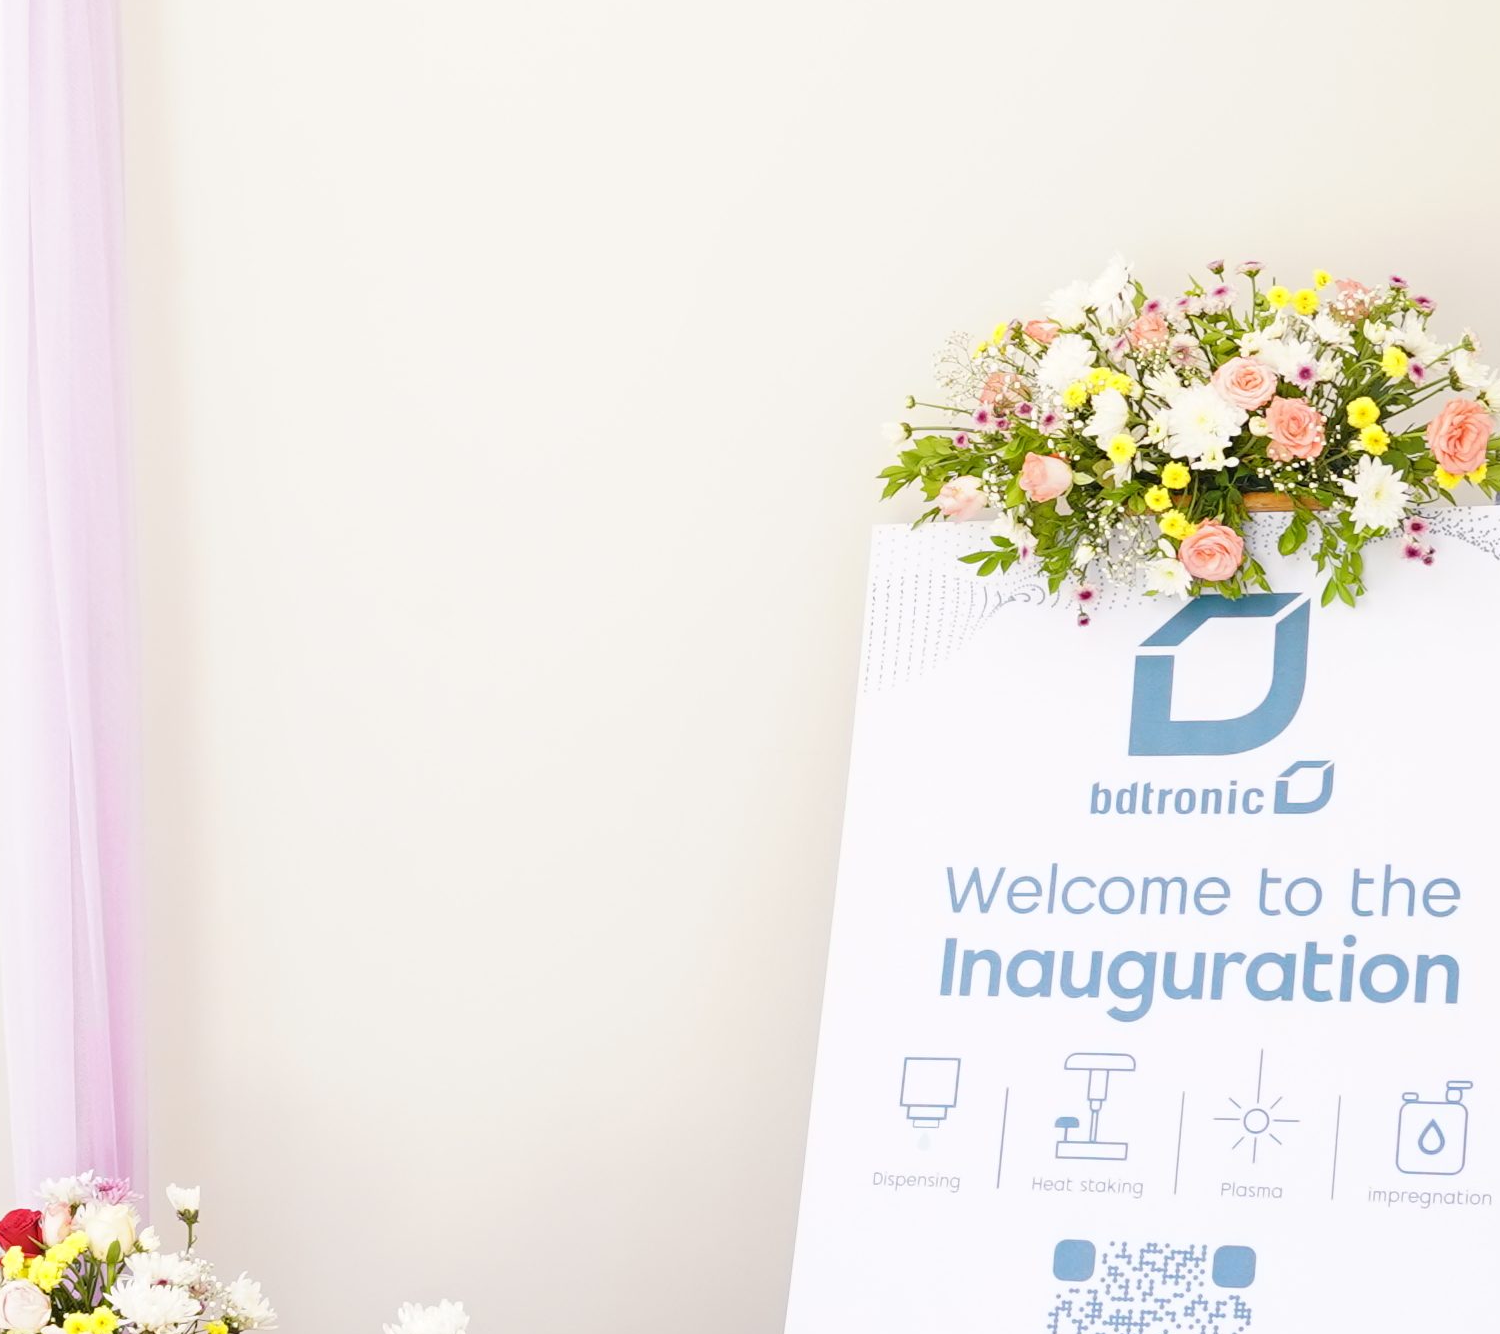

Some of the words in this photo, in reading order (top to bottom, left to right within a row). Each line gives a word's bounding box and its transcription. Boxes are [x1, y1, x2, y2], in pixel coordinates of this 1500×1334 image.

[1090, 780, 1265, 815] bdtronic
[945, 862, 1231, 917] Welcome
[1258, 867, 1324, 917] to
[1350, 863, 1462, 919] the
[939, 933, 1461, 1023] Inauguration
[872, 1171, 961, 1194] Dispensing
[1032, 1176, 1073, 1192] Heat
[1080, 1178, 1144, 1199] staking
[1220, 1181, 1283, 1199] Plasma
[1368, 1186, 1492, 1209] impregnation
